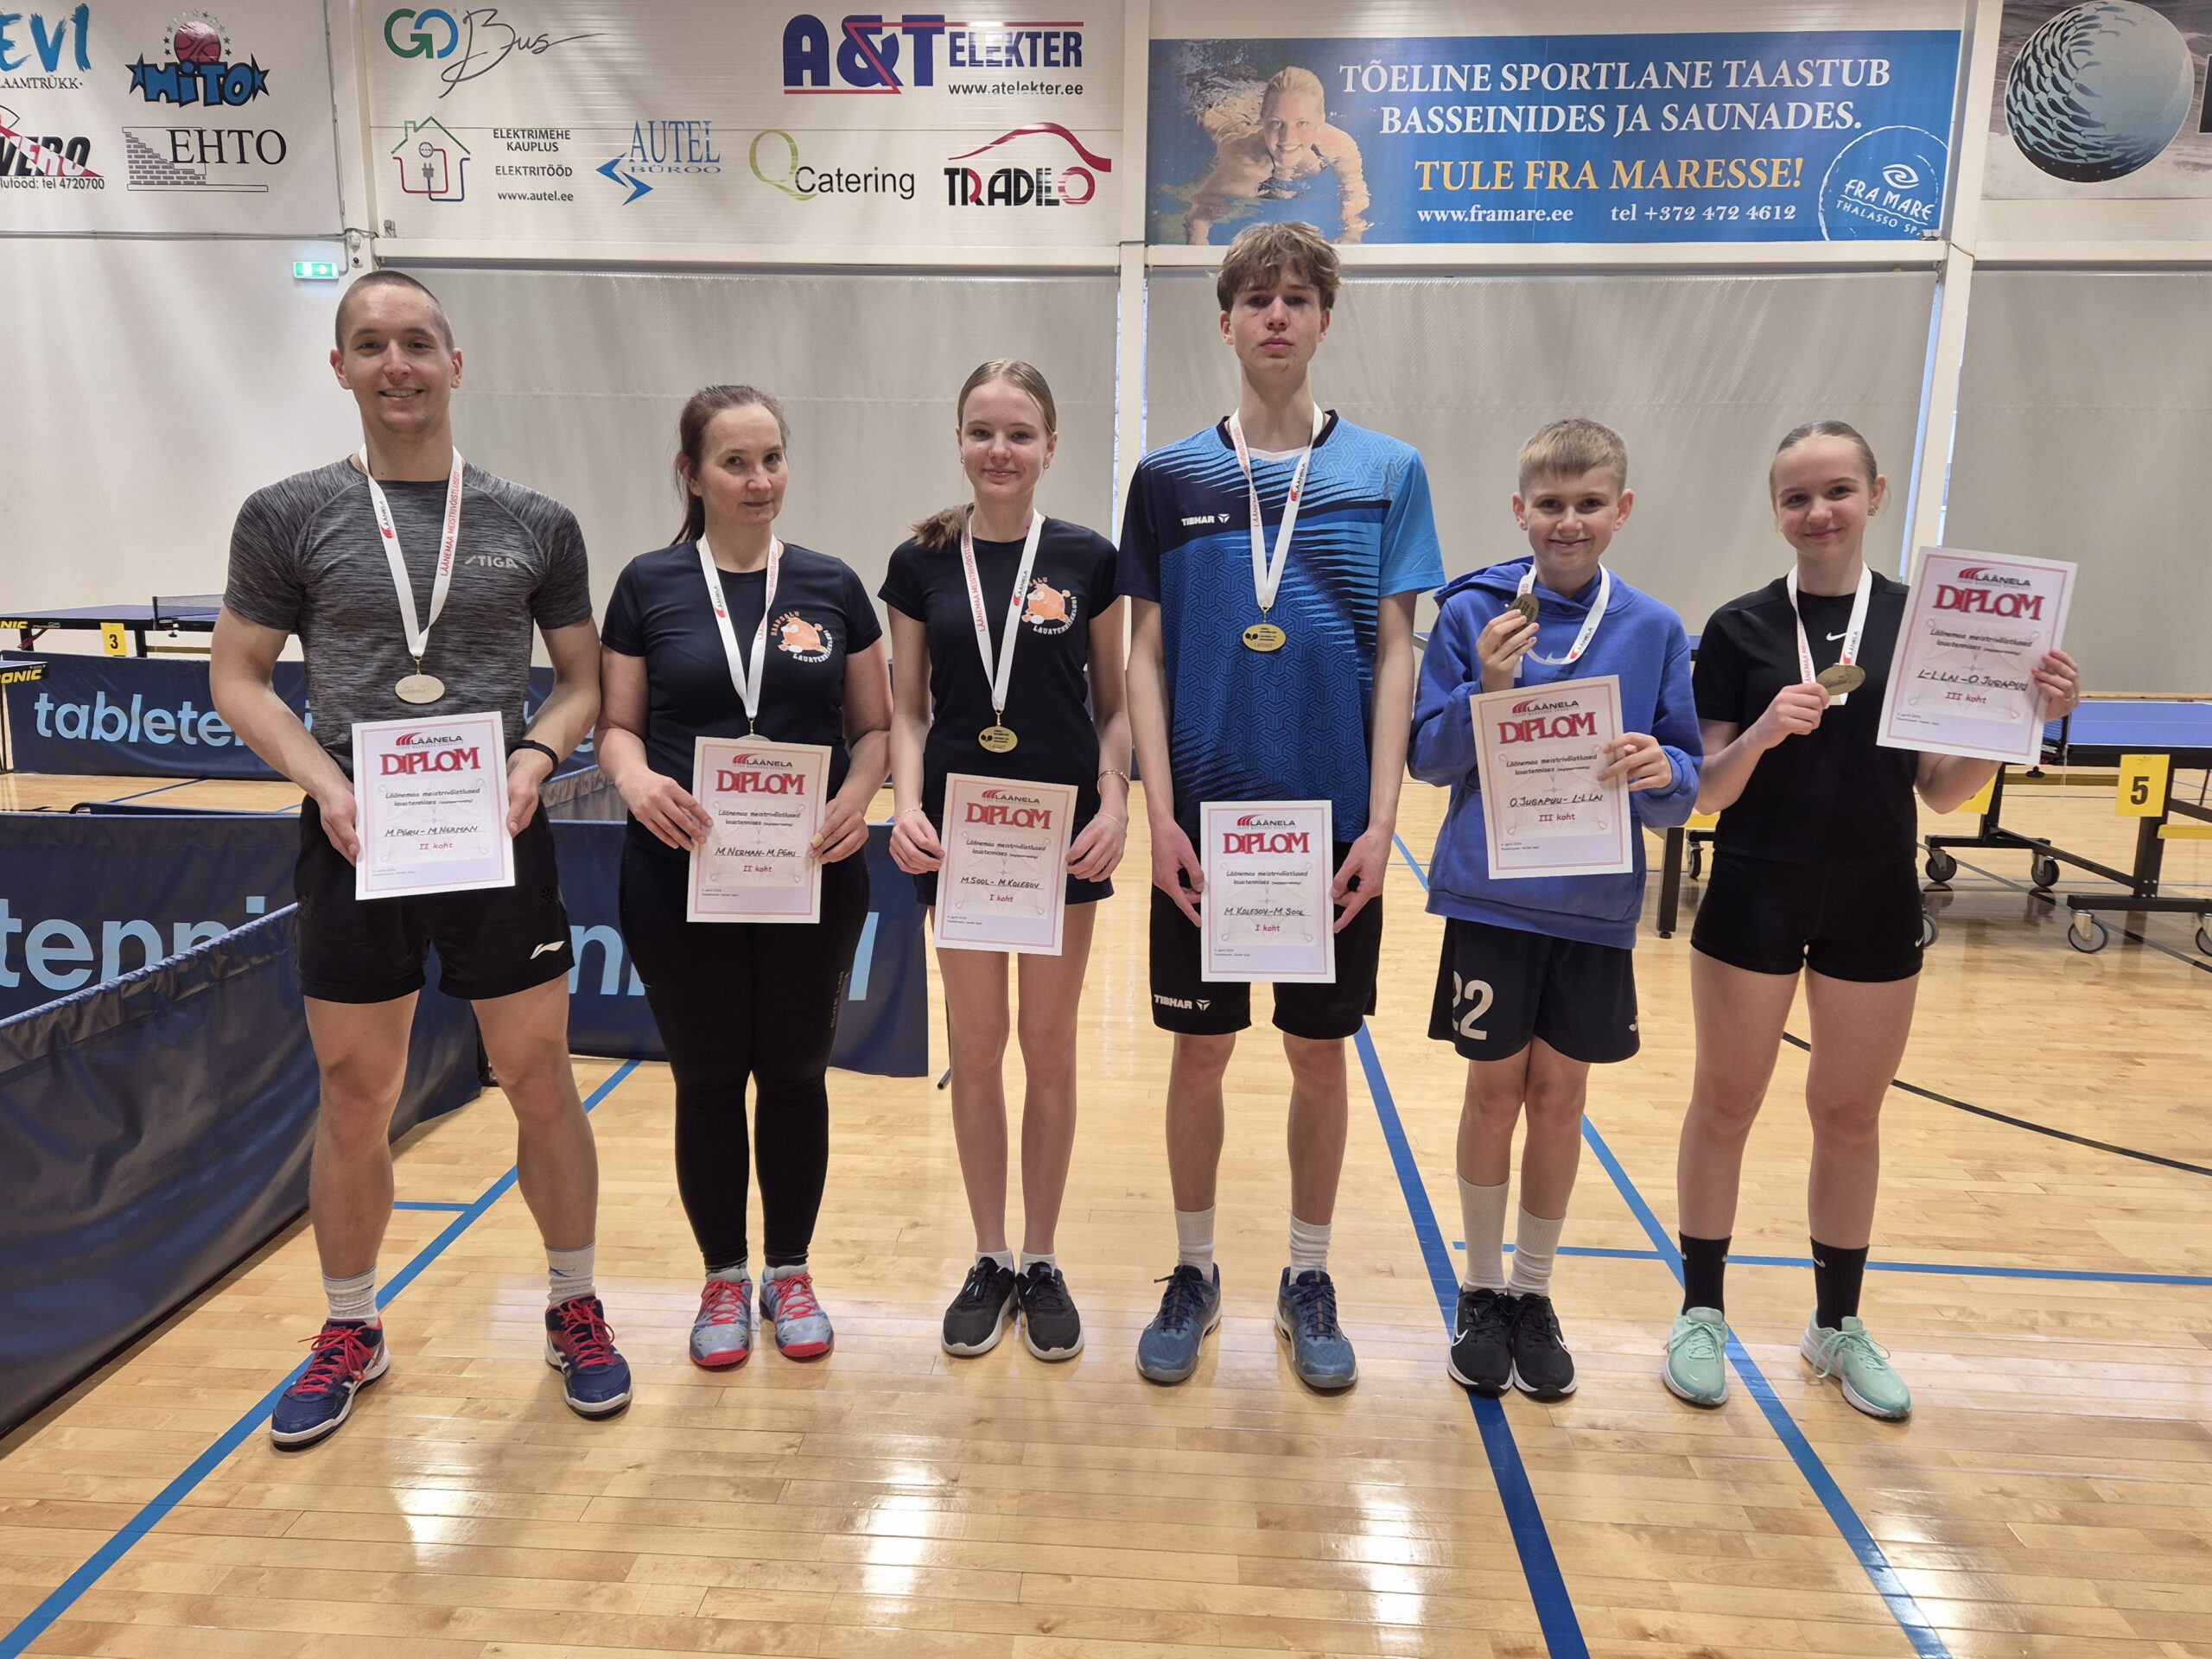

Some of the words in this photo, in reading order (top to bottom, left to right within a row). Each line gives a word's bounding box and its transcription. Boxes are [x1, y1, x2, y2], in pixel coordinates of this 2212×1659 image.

[438, 9, 610, 99] Bus
[783, 14, 944, 87] A&T
[950, 31, 1082, 67] ELEKTER
[1339, 60, 1492, 92] TÕELINE
[1500, 60, 1713, 92] SPORTLANE
[1722, 59, 1891, 88] TAASTUB
[949, 81, 1084, 95] www.atelekter.ee
[1379, 105, 1606, 134] BASSEINIDES
[1613, 104, 1651, 138] JA
[1660, 101, 1862, 130] SAUNADES.
[493, 128, 571, 140] ELEKTRIMEHE
[629, 120, 721, 163] AUTEL
[167, 129, 287, 164] EHTO
[506, 141, 559, 152] KAUPLUS
[495, 164, 573, 177] ELEKTRITÖÖD
[631, 163, 721, 174] BÜROO
[1414, 160, 1515, 191] TULE
[1523, 159, 1599, 190] FRA
[1609, 157, 1804, 190] MARESSE!
[42, 178, 56, 189] tel
[60, 178, 105, 189] 4720700
[794, 166, 915, 200] Catering
[498, 190, 574, 202] www.autel.ee
[1844, 179, 1880, 202] FRA
[1883, 191, 1935, 220] MARE
[1417, 203, 1574, 222] www.framare.ee
[1611, 203, 1637, 221] tel
[1644, 205, 1696, 221] +372
[1702, 205, 1740, 220] 472
[1745, 205, 1796, 221] 4612
[1836, 200, 1898, 227] THALASSO
[1181, 515, 1215, 526] TIBHAR
[1974, 573, 2031, 587] LÄÄNELA
[1933, 584, 2045, 620] DIPLOM
[109, 634, 118, 649] 3
[1527, 699, 1580, 712] LÄÄNELA
[1945, 691, 1963, 701] III
[1966, 693, 1986, 704] koht
[1497, 711, 1598, 744] DIPLOM
[410, 735, 463, 745] LÄÄNELA
[379, 747, 481, 775] DIPLOM
[746, 758, 793, 768] LÄÄNELA
[715, 769, 806, 795] DIPLOM
[2130, 776, 2150, 805] 5
[995, 793, 1040, 804] LÄÄNELA
[965, 802, 1052, 830] DIPLOM
[1223, 832, 1311, 854] DIPLOM
[1154, 995, 1192, 1009] TIBHAR
